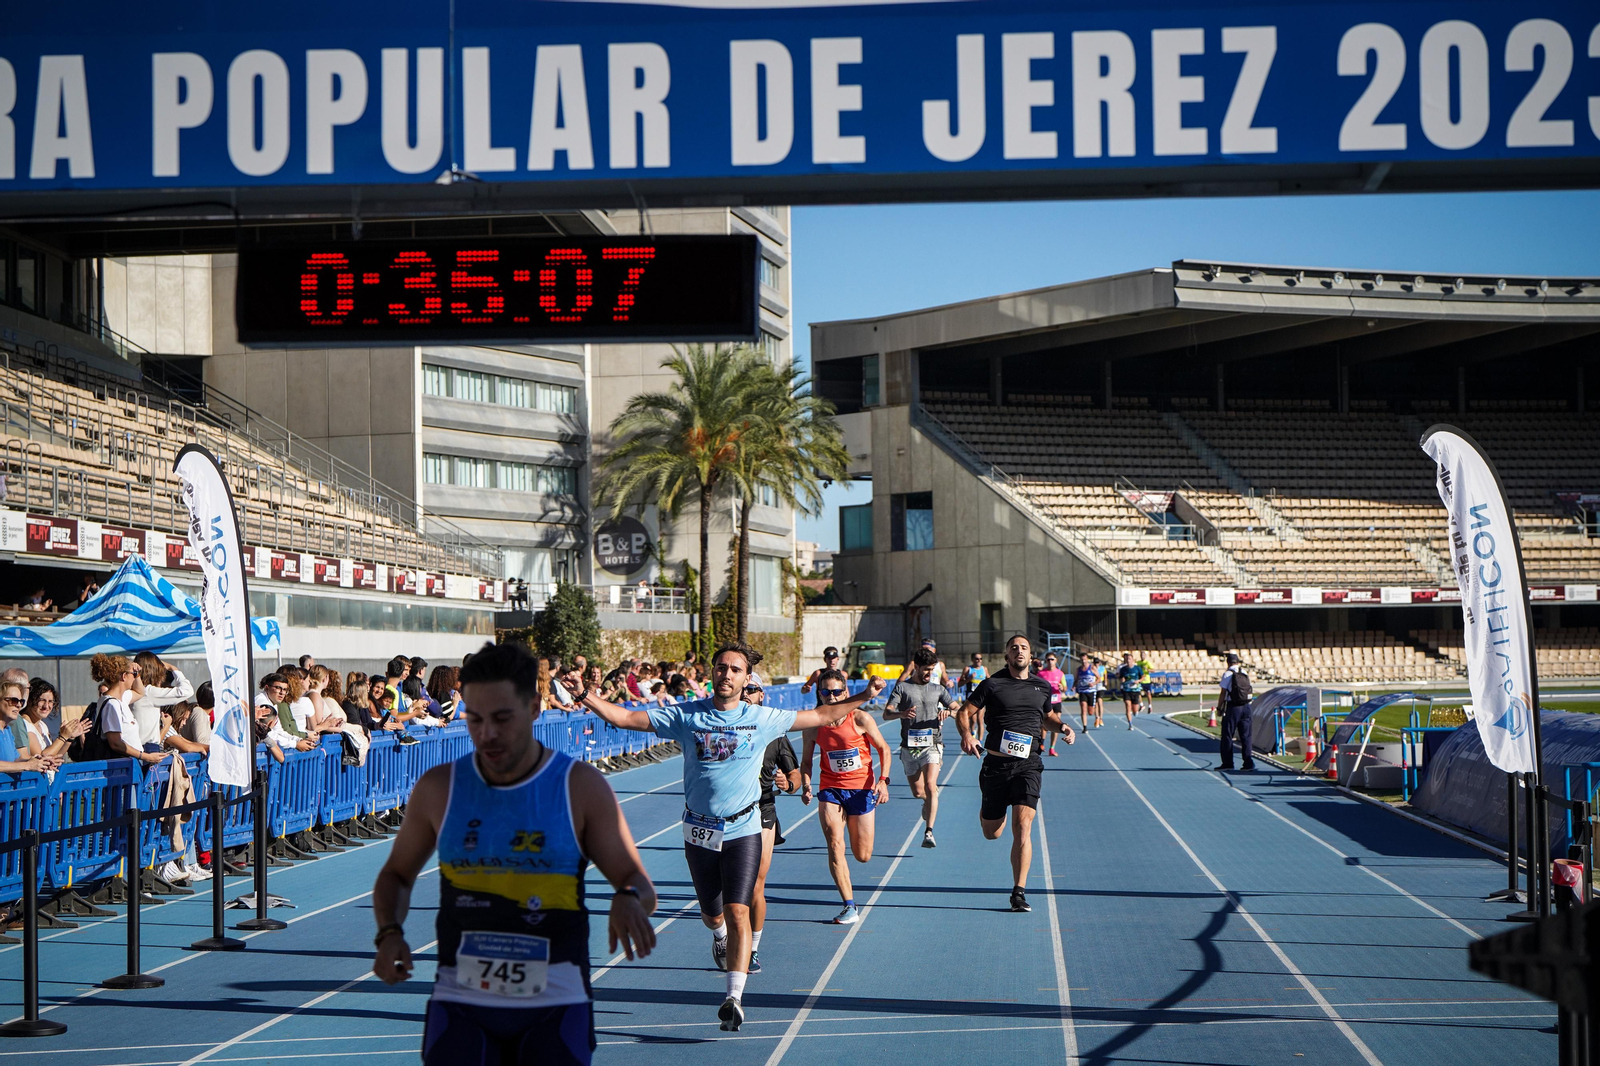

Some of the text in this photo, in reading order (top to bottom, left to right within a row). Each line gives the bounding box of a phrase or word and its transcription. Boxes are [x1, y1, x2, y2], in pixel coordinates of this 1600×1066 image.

[0, 19, 1600, 180] A POPULAR DE JEREZ 202
[300, 247, 656, 325] 0:35:07
[29, 524, 49, 540] PLAY
[45, 526, 71, 550] JEREZ
[104, 535, 121, 549] PLAY
[598, 533, 647, 555] B&B
[168, 543, 183, 558] PLAY
[605, 556, 640, 565] HOTELS
[1237, 592, 1260, 600] PLAY
[1415, 591, 1437, 599] PLAY
[1008, 741, 1025, 752] 666
[836, 758, 854, 768] 555
[691, 827, 714, 841] 687
[478, 943, 501, 952] Ciudad
[487, 936, 512, 944] Carrera
[514, 938, 539, 946] Popular
[477, 959, 526, 983] 745
